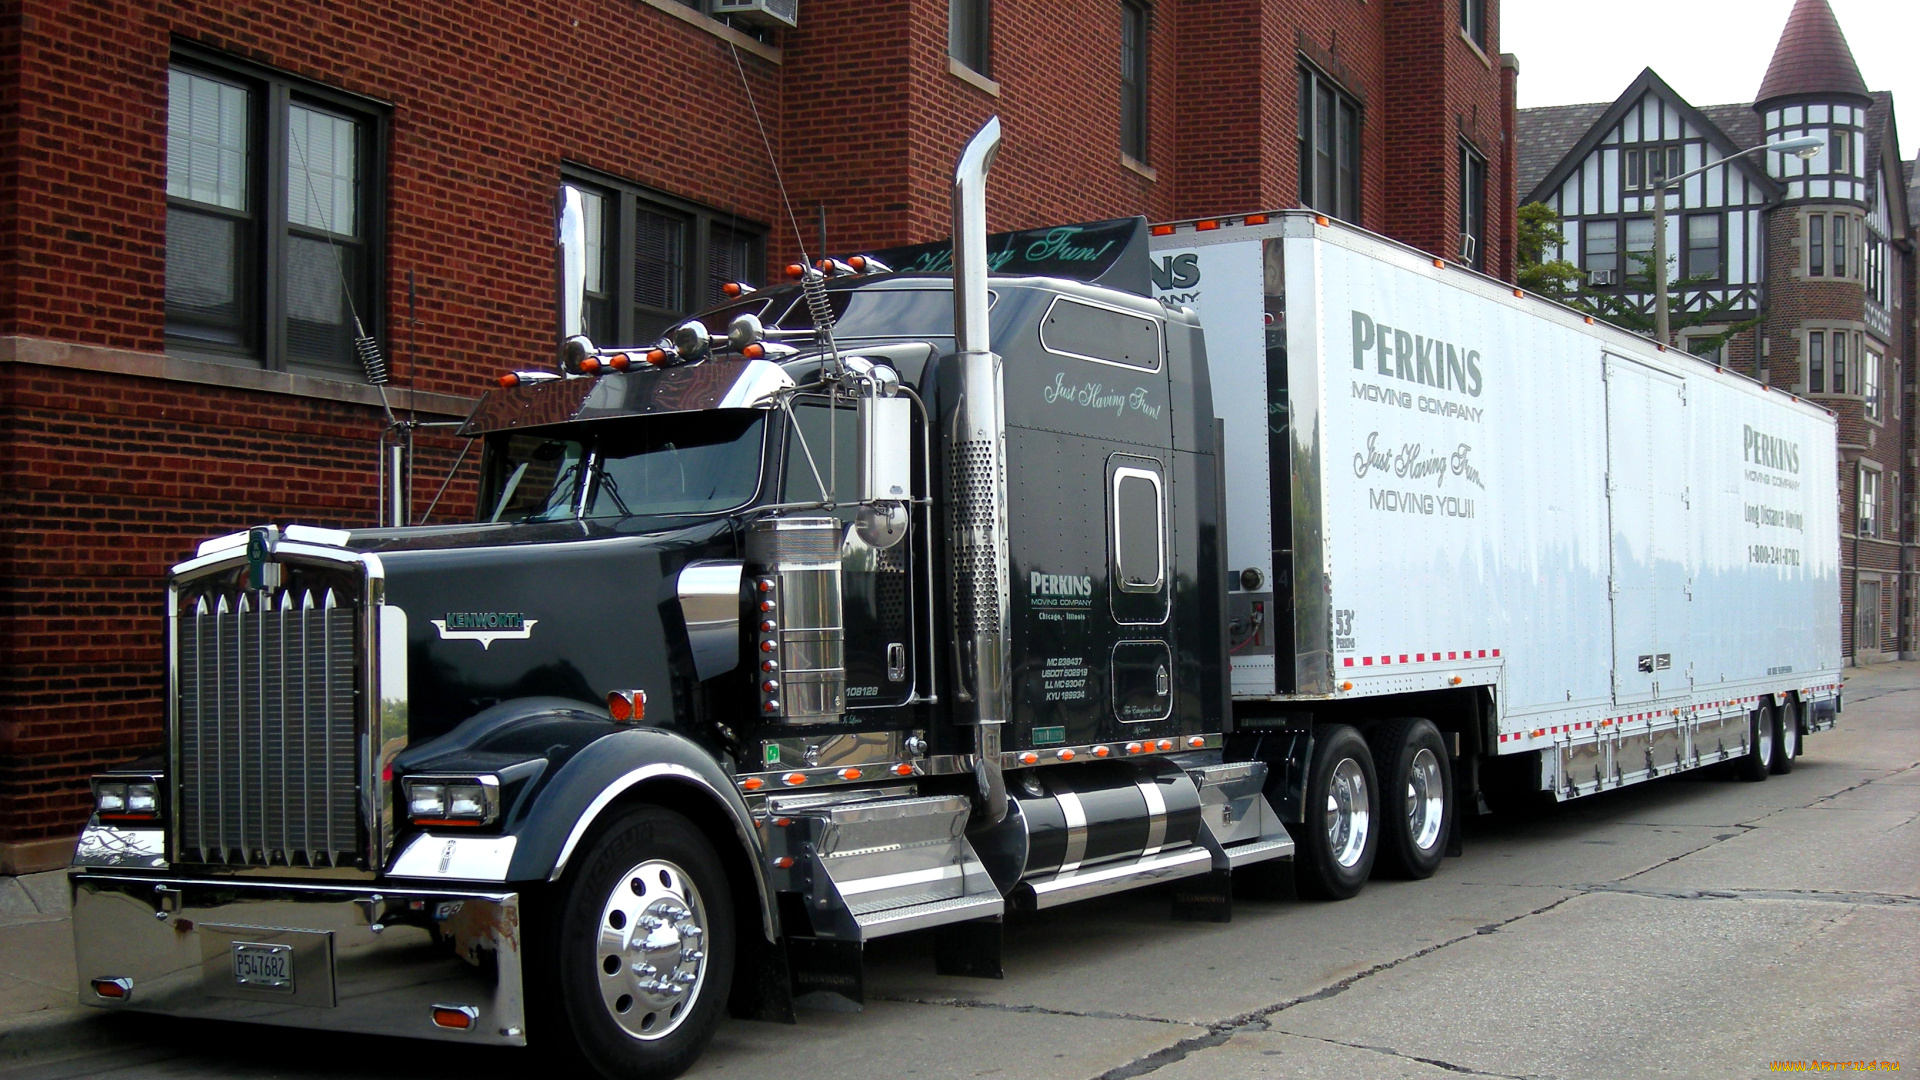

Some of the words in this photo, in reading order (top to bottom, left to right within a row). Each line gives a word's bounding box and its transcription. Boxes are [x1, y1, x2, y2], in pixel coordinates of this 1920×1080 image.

[1026, 227, 1116, 261] Fun!
[1352, 310, 1482, 397] PERKINS
[1044, 372, 1077, 403] Just
[1079, 383, 1125, 416] Having
[1129, 387, 1160, 419] Fun!
[1352, 381, 1412, 408] MOVING
[1418, 396, 1483, 423] COMPANY
[1354, 431, 1392, 479] Just
[1394, 443, 1447, 488] Having
[1744, 424, 1799, 474] PERKINS
[1744, 469, 1770, 485] MOVING
[1772, 475, 1801, 491] COMPANY
[1369, 488, 1434, 514] MOVING
[1744, 501, 1759, 529] Long
[1761, 504, 1784, 527] Distance
[1031, 571, 1092, 596] PERKINS
[446, 612, 524, 628] KENWORTH
[1039, 612, 1063, 621] Chicago,
[1066, 612, 1086, 621] Illinois
[1336, 609, 1355, 636] 53'
[1336, 637, 1355, 649] PERKINS
[1042, 669, 1064, 678] USDOT
[1046, 658, 1058, 666] MC
[1046, 692, 1061, 700] KYU
[237, 954, 286, 977] P547682
